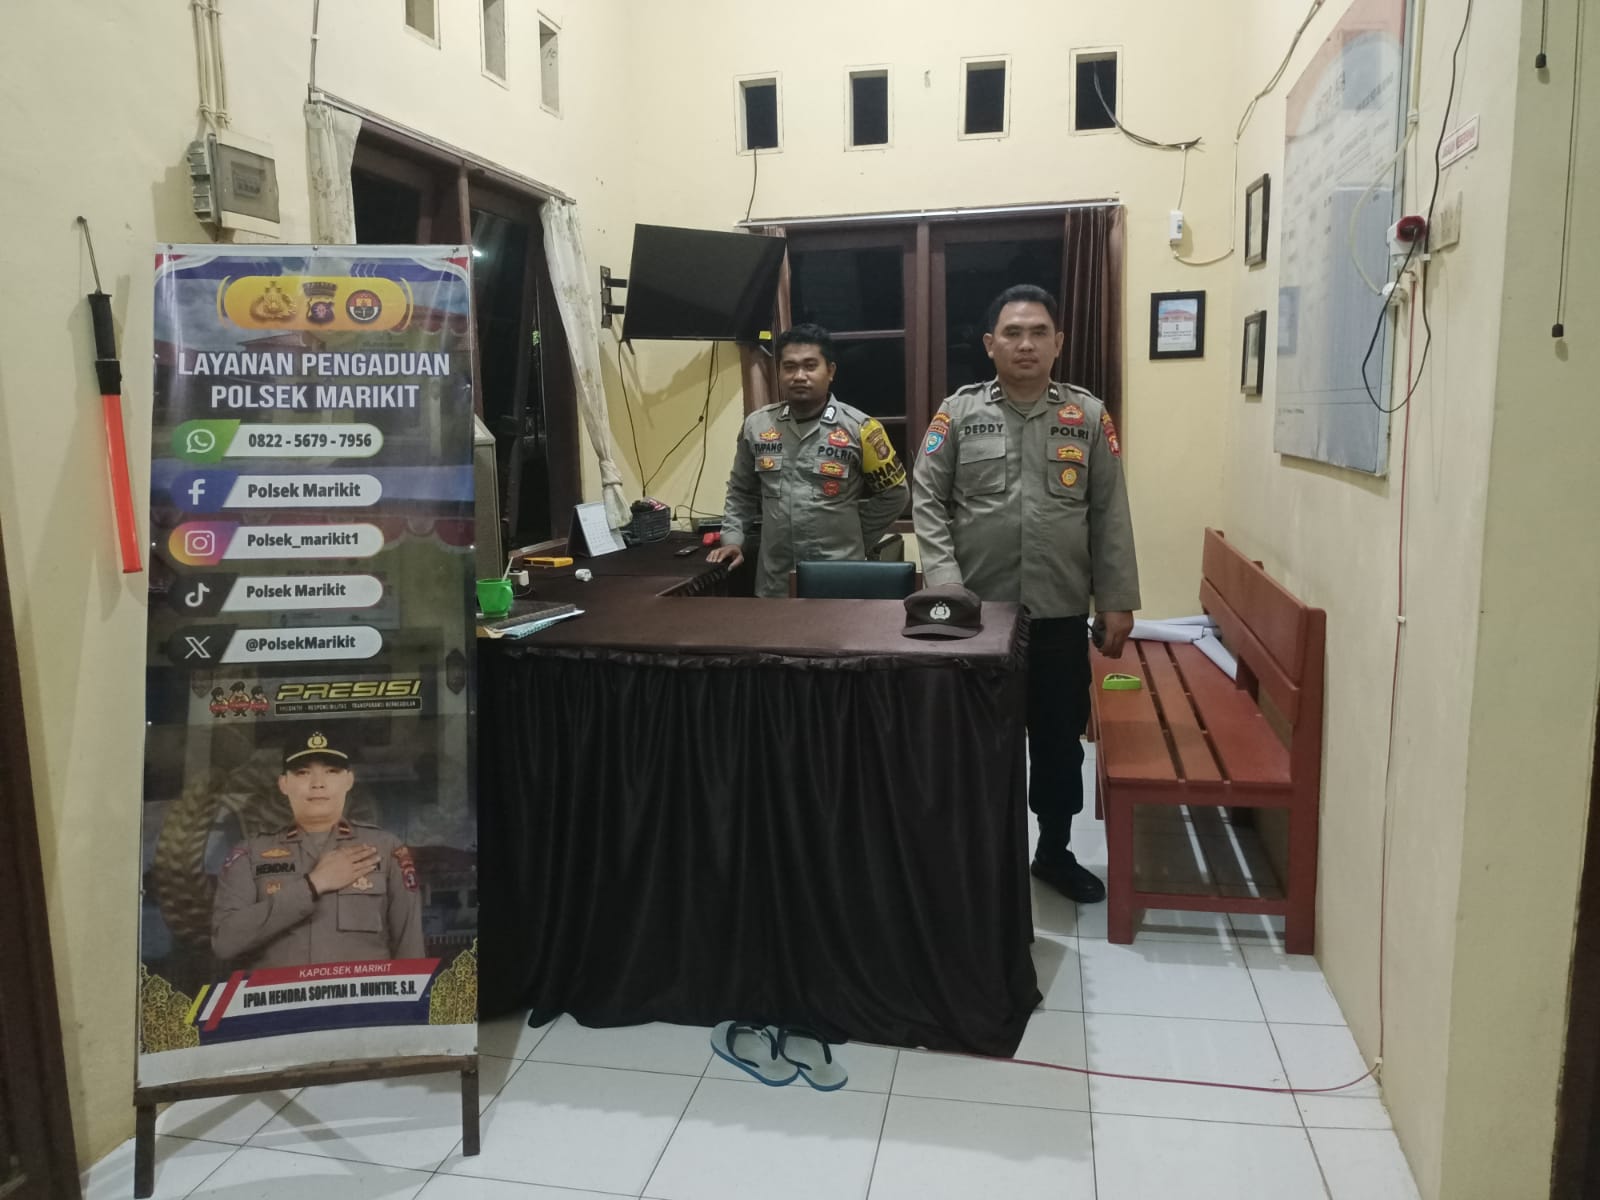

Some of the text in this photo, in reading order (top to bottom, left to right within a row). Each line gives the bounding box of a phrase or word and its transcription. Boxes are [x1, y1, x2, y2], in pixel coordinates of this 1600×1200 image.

[178, 352, 450, 377] LAYANAN PENGADUAN
[211, 384, 419, 408] POLSEK MARIKIT
[964, 423, 1004, 436] DEDDY
[1050, 426, 1089, 440] POLRI
[248, 432, 282, 448] 0822
[294, 432, 328, 448] 5679
[339, 432, 372, 448] 7956
[817, 445, 851, 460] POLRI
[248, 482, 361, 498] Polsek Marikit
[247, 532, 359, 550] Polsek_marikit1
[246, 583, 346, 599] Polsek Marikit
[245, 635, 356, 652] @PolsekMarikit
[276, 680, 421, 700] PRESISI
[255, 861, 296, 875] HENDRA
[299, 963, 392, 978] KAPOLSEK MARIKIT
[243, 980, 417, 1009] IPDA HENDRA SOPIYAN D. MUNTHE, S.H.
